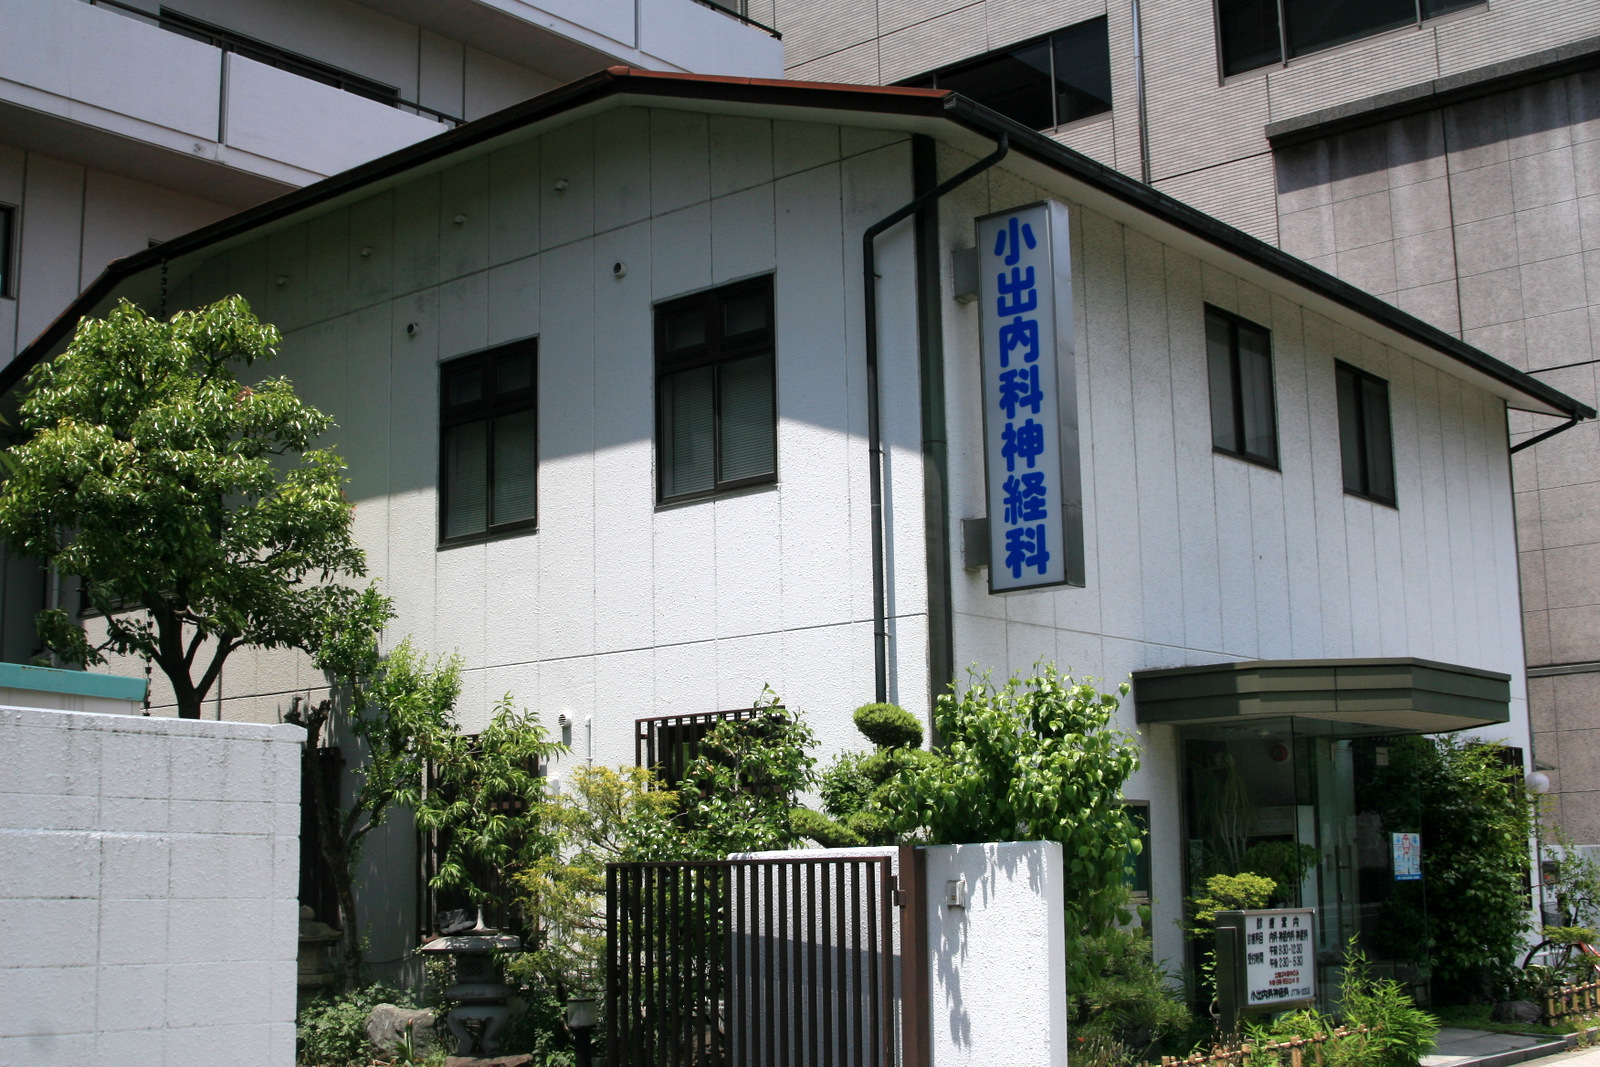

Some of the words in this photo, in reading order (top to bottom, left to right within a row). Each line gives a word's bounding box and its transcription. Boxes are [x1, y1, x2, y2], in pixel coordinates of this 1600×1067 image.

[994, 217, 1050, 579] 小出内科神経科
[1251, 987, 1289, 1001] 小出内科神経科
